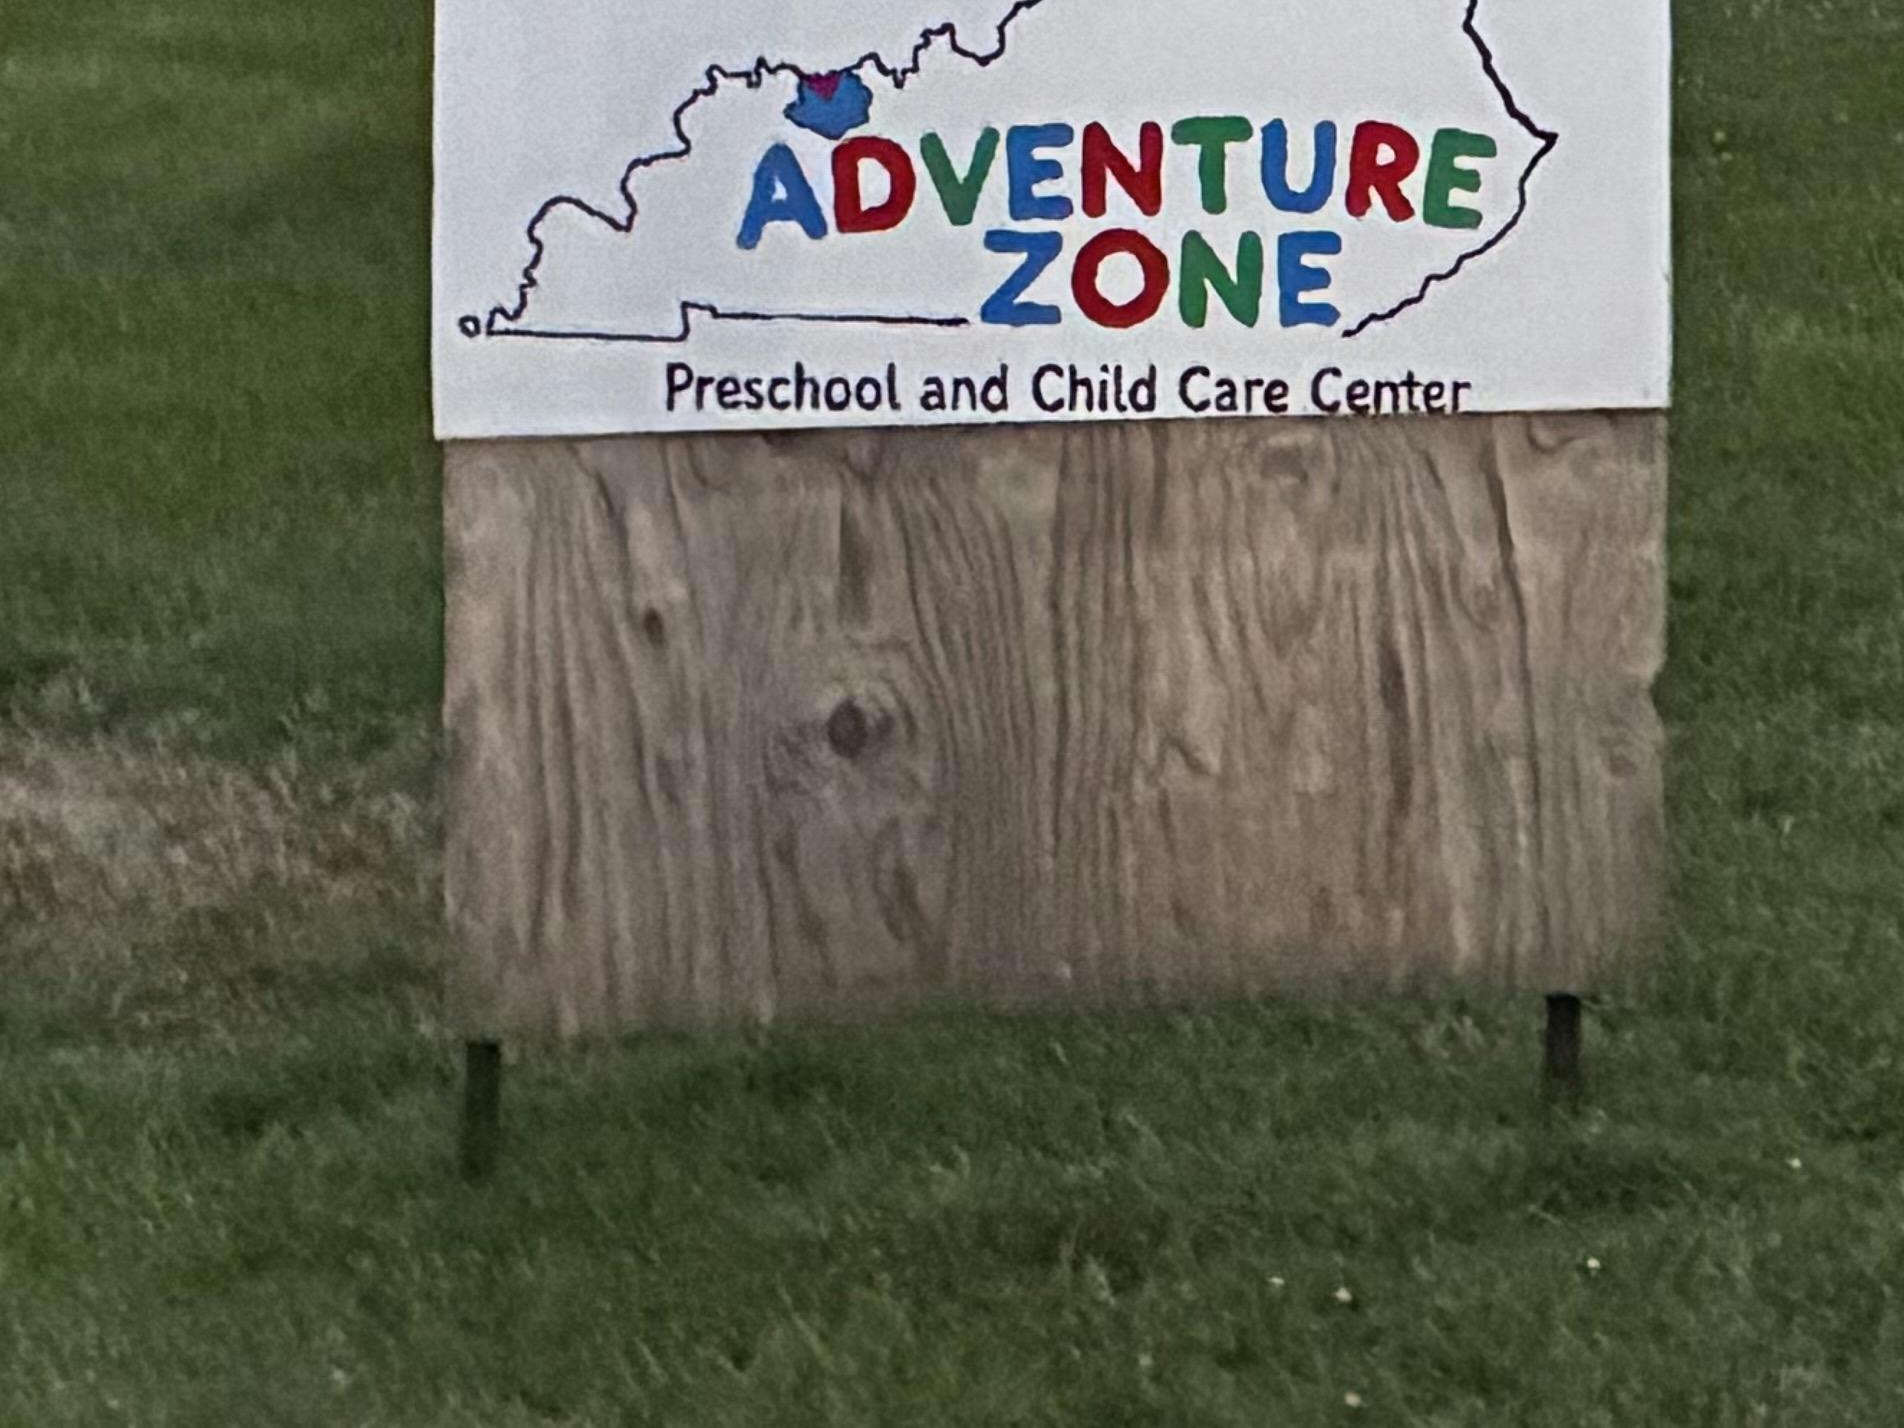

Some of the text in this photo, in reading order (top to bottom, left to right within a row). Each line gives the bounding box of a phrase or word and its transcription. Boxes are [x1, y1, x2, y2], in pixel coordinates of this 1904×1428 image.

[736, 116, 1496, 250] ADVENTURE
[979, 228, 1343, 329] ZONE
[666, 361, 1471, 415] Preschool and Child Care Center
